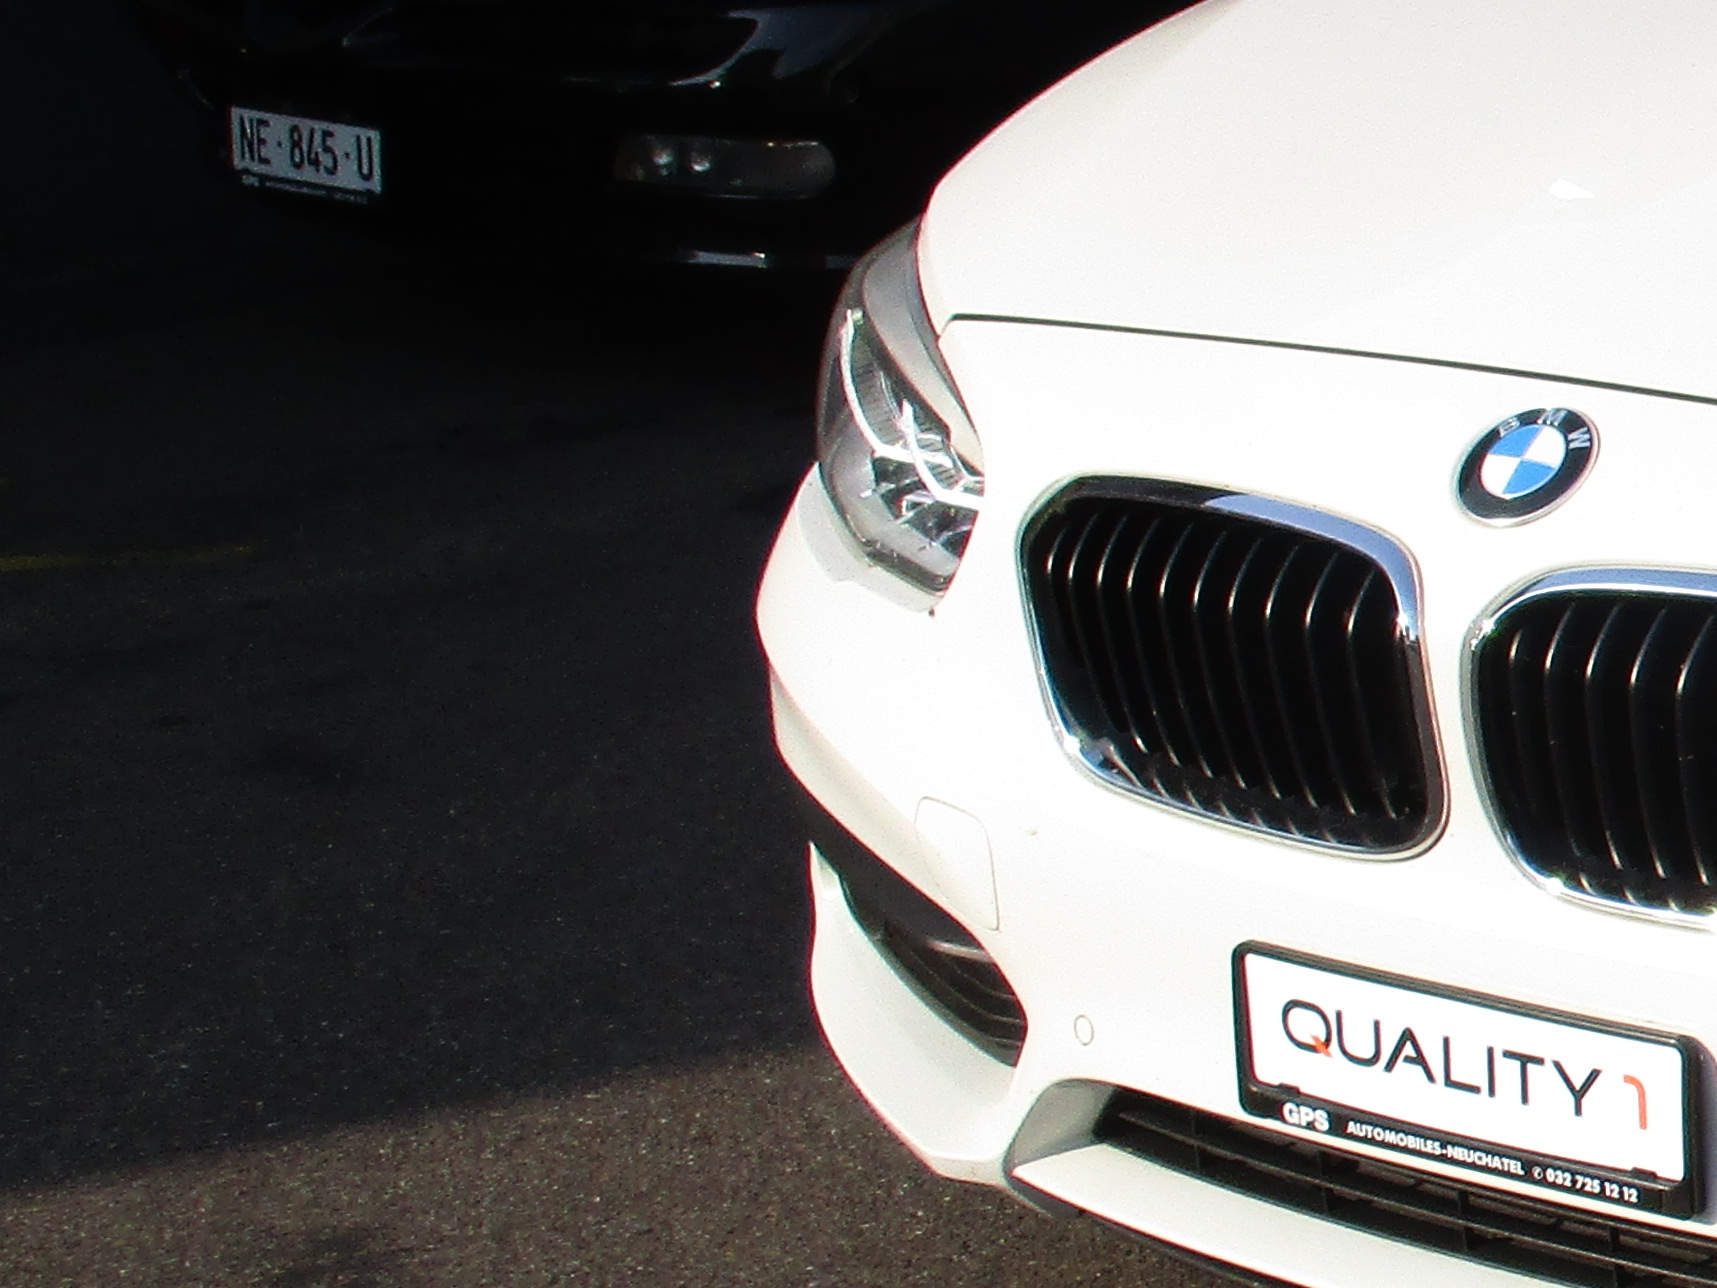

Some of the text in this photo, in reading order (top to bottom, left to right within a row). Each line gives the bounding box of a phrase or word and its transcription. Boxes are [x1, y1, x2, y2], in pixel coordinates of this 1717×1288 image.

[1499, 409, 1590, 450] BMW
[1281, 1101, 1331, 1132] GPS
[1545, 1166, 1573, 1187] 032
[1574, 1172, 1601, 1195] 725
[1603, 1180, 1621, 1199] 12
[1622, 1185, 1639, 1203] 12
